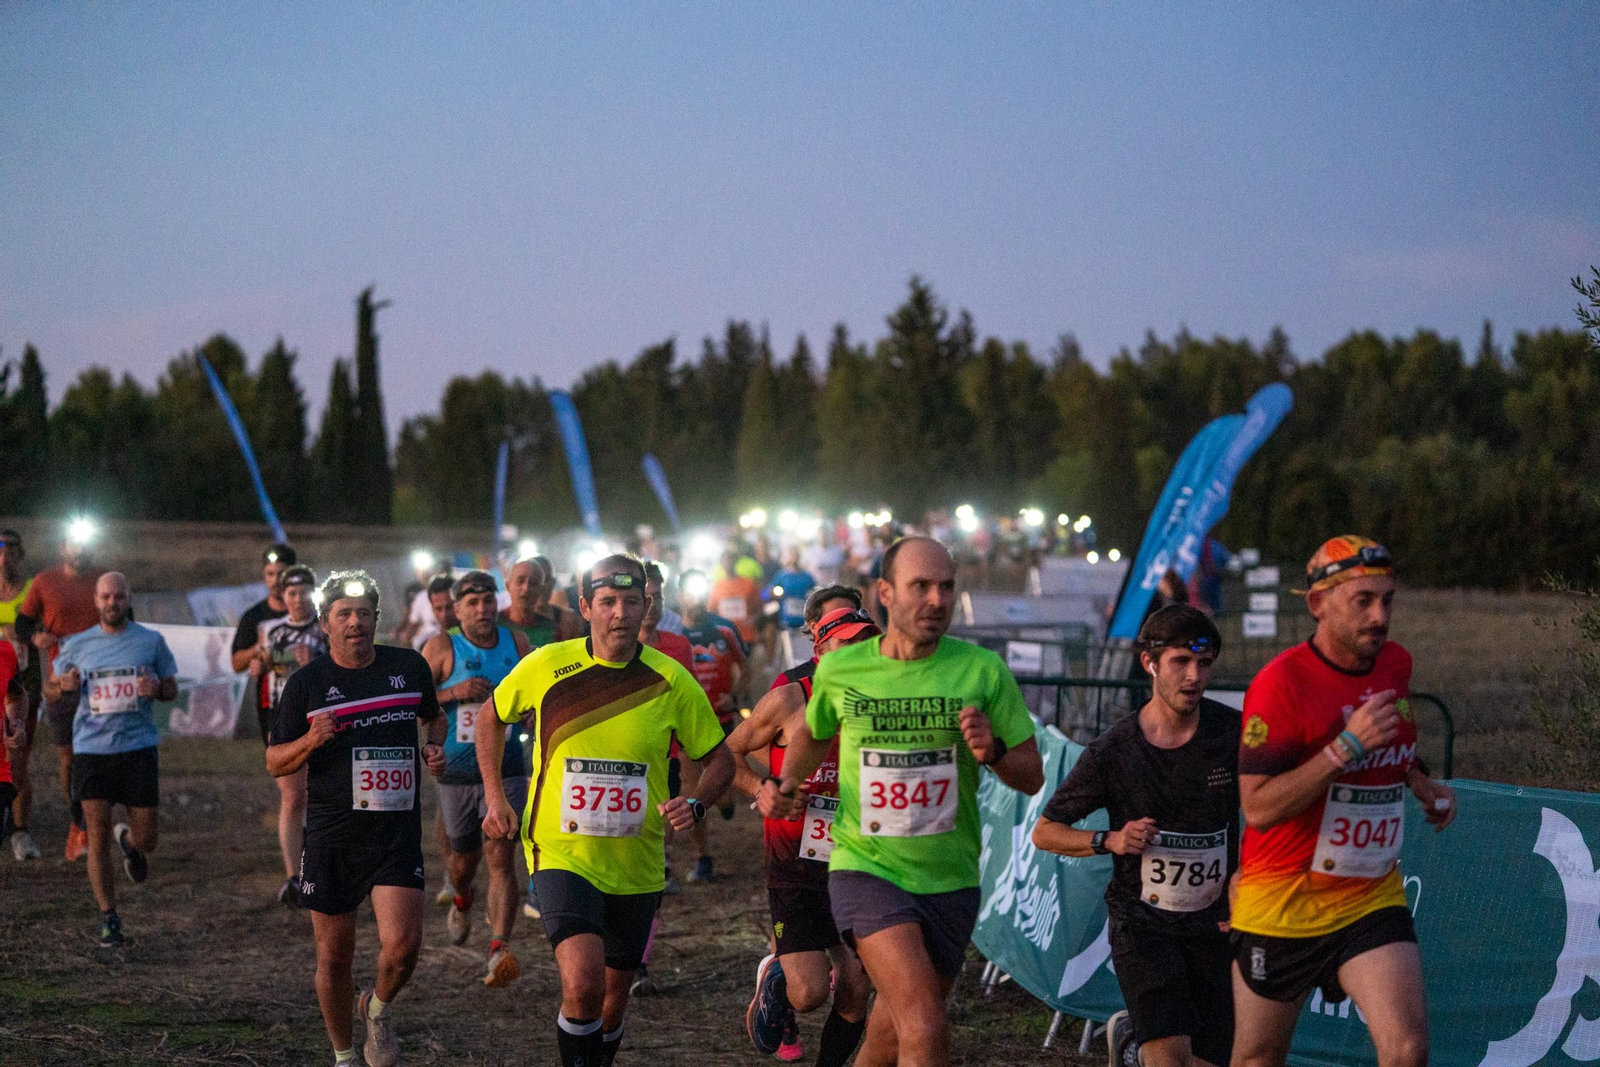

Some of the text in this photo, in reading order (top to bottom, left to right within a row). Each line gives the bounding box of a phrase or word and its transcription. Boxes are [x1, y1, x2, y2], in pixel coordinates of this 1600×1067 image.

[94, 682, 134, 699] 3170
[856, 698, 942, 715] CARRERAS
[360, 769, 412, 791] 3890
[870, 778, 950, 810] 3847
[570, 785, 642, 813] 3736
[1329, 817, 1401, 849] 3047
[1150, 858, 1222, 887] 3784
